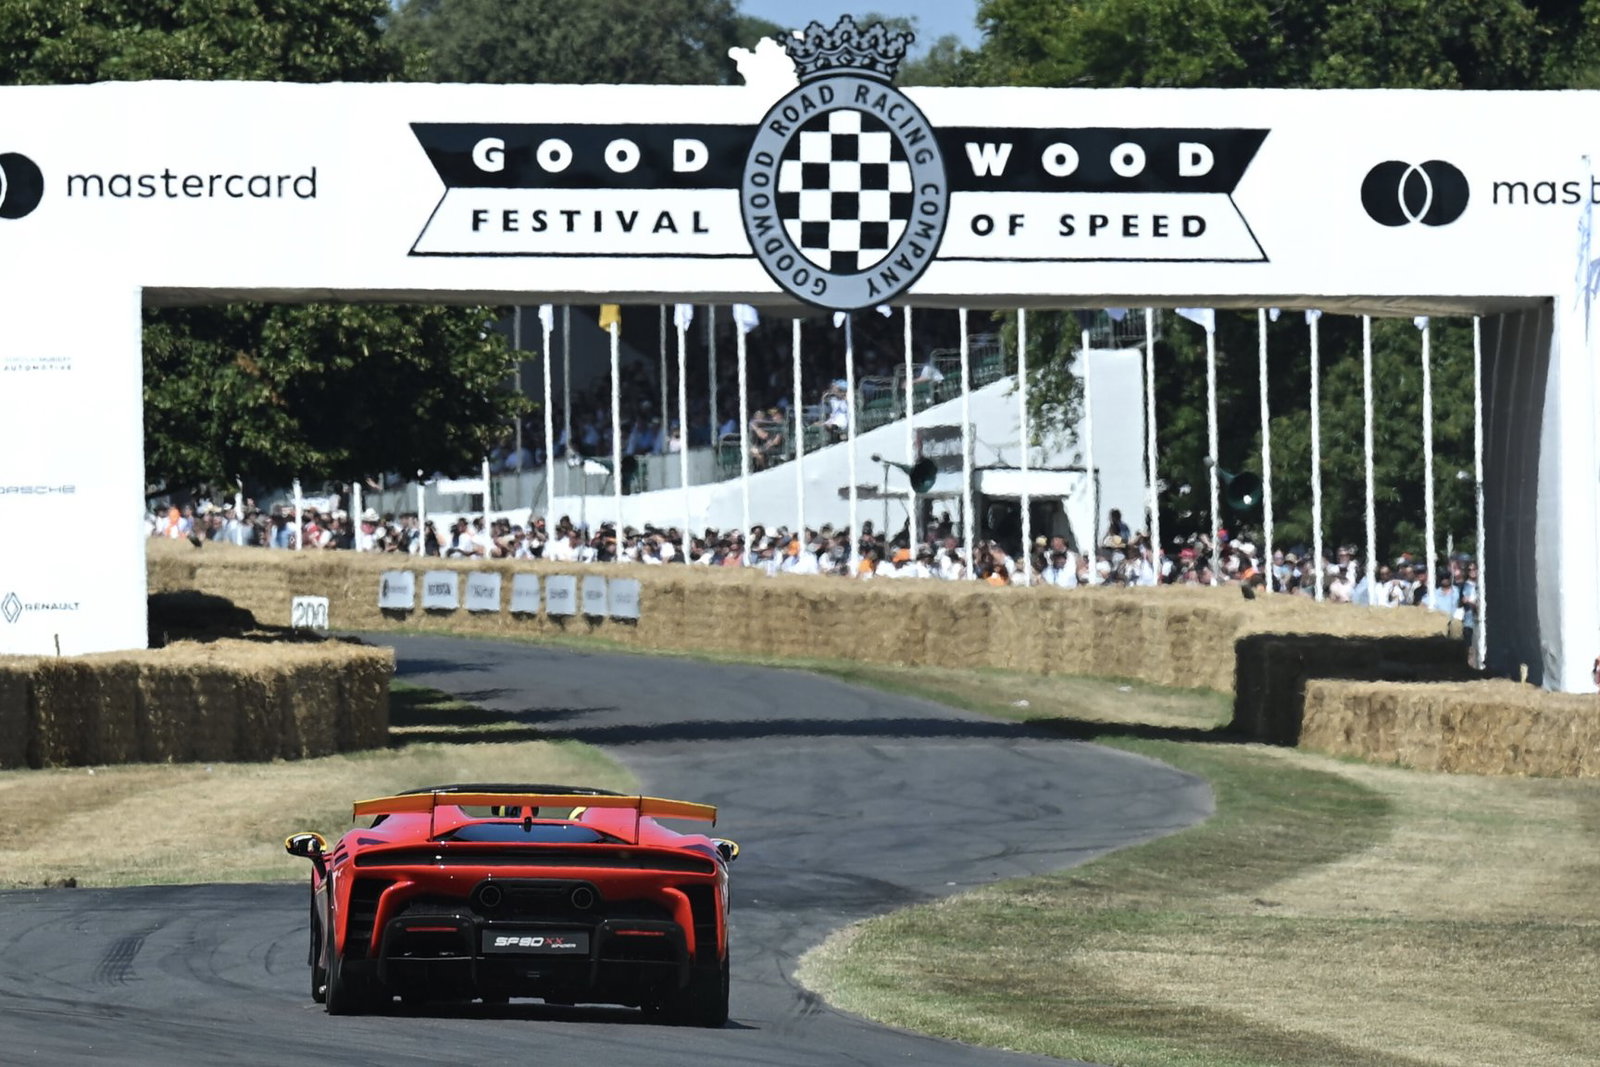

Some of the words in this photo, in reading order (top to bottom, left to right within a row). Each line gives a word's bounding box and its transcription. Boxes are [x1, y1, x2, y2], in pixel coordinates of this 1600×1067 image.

[769, 84, 835, 137] ROAD
[854, 84, 934, 165] RACING
[472, 137, 709, 173] GOOD
[965, 142, 1214, 177] WOOD
[67, 166, 317, 199] mastercard
[472, 209, 709, 234] FESTIVAL
[971, 213, 1025, 237] OF
[1059, 213, 1206, 238] SPEED
[751, 152, 827, 296] GOODWOOD
[867, 183, 939, 297] COMPANY
[24, 602, 80, 611] RENAULT
[494, 937, 544, 947] SF90
